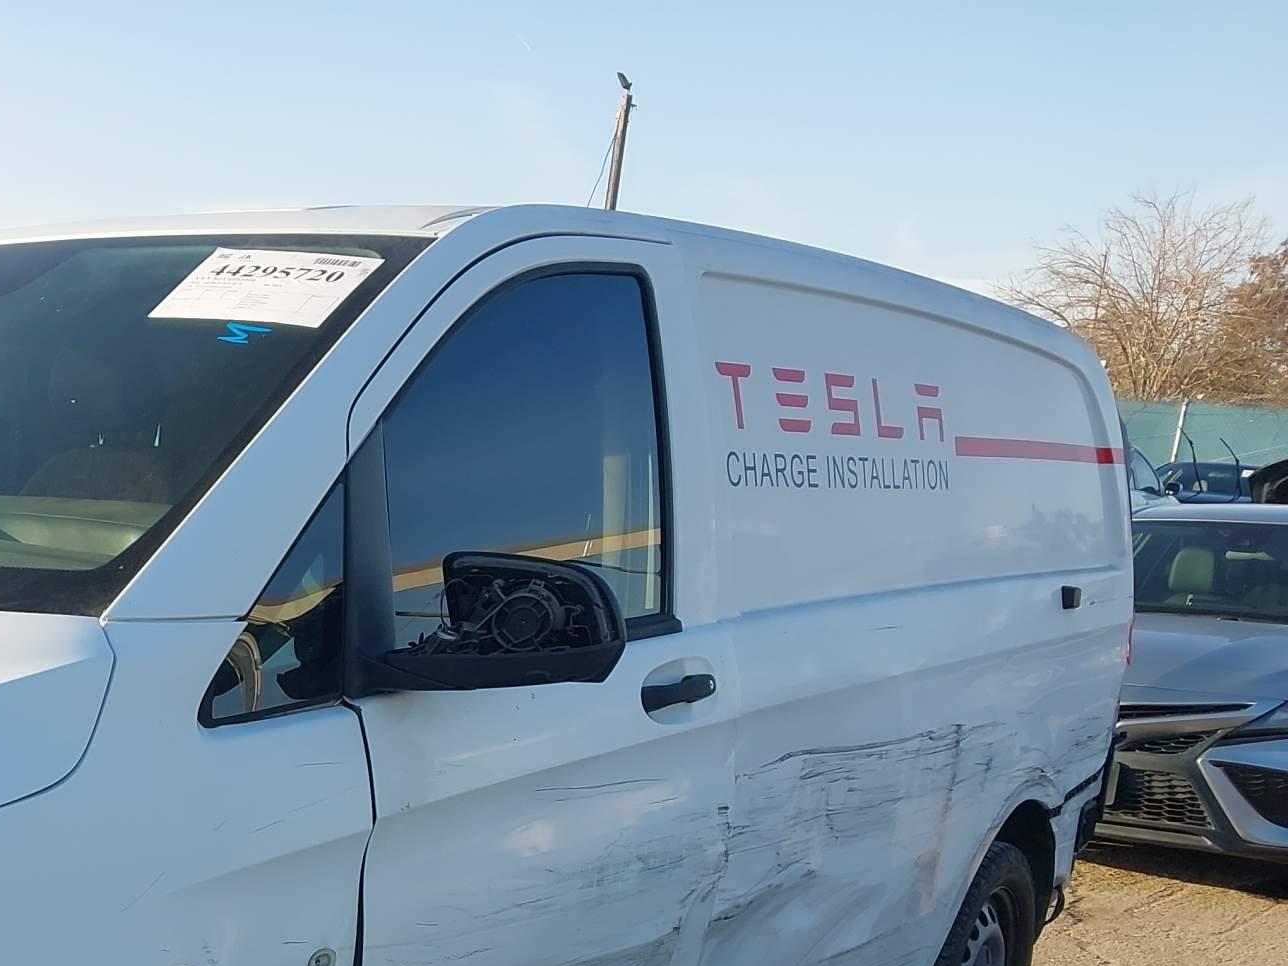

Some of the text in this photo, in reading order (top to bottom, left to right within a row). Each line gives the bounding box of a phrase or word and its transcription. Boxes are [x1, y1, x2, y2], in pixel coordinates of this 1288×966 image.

[210, 263, 345, 283] 44295720
[714, 361, 945, 442] TESLA
[726, 451, 950, 491] CHARGE INSTALLATION
